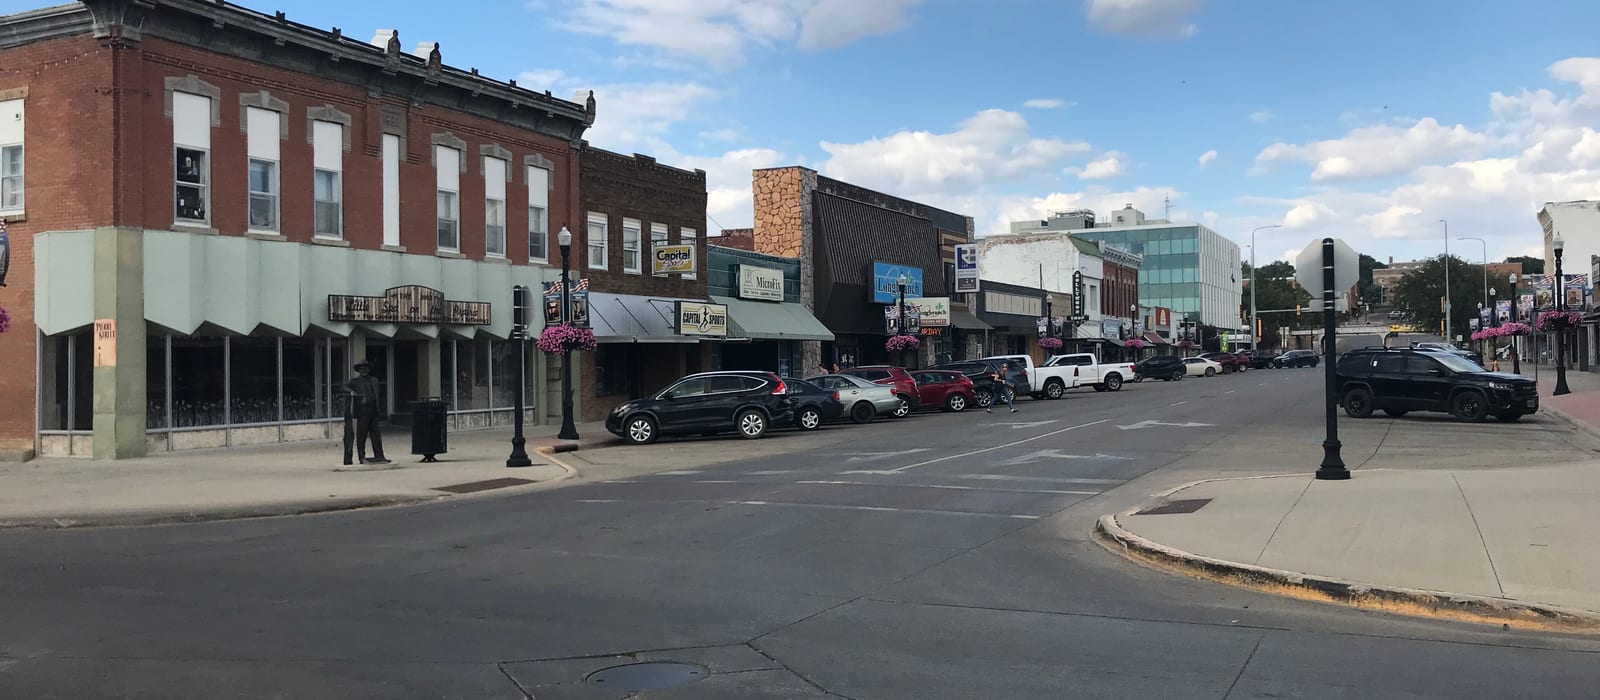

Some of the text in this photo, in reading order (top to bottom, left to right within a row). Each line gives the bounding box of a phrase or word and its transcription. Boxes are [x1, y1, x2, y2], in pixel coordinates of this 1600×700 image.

[656, 249, 690, 261] Capital
[756, 276, 781, 291] MicroFix
[682, 312, 726, 326] CAPITAL SPORTS
